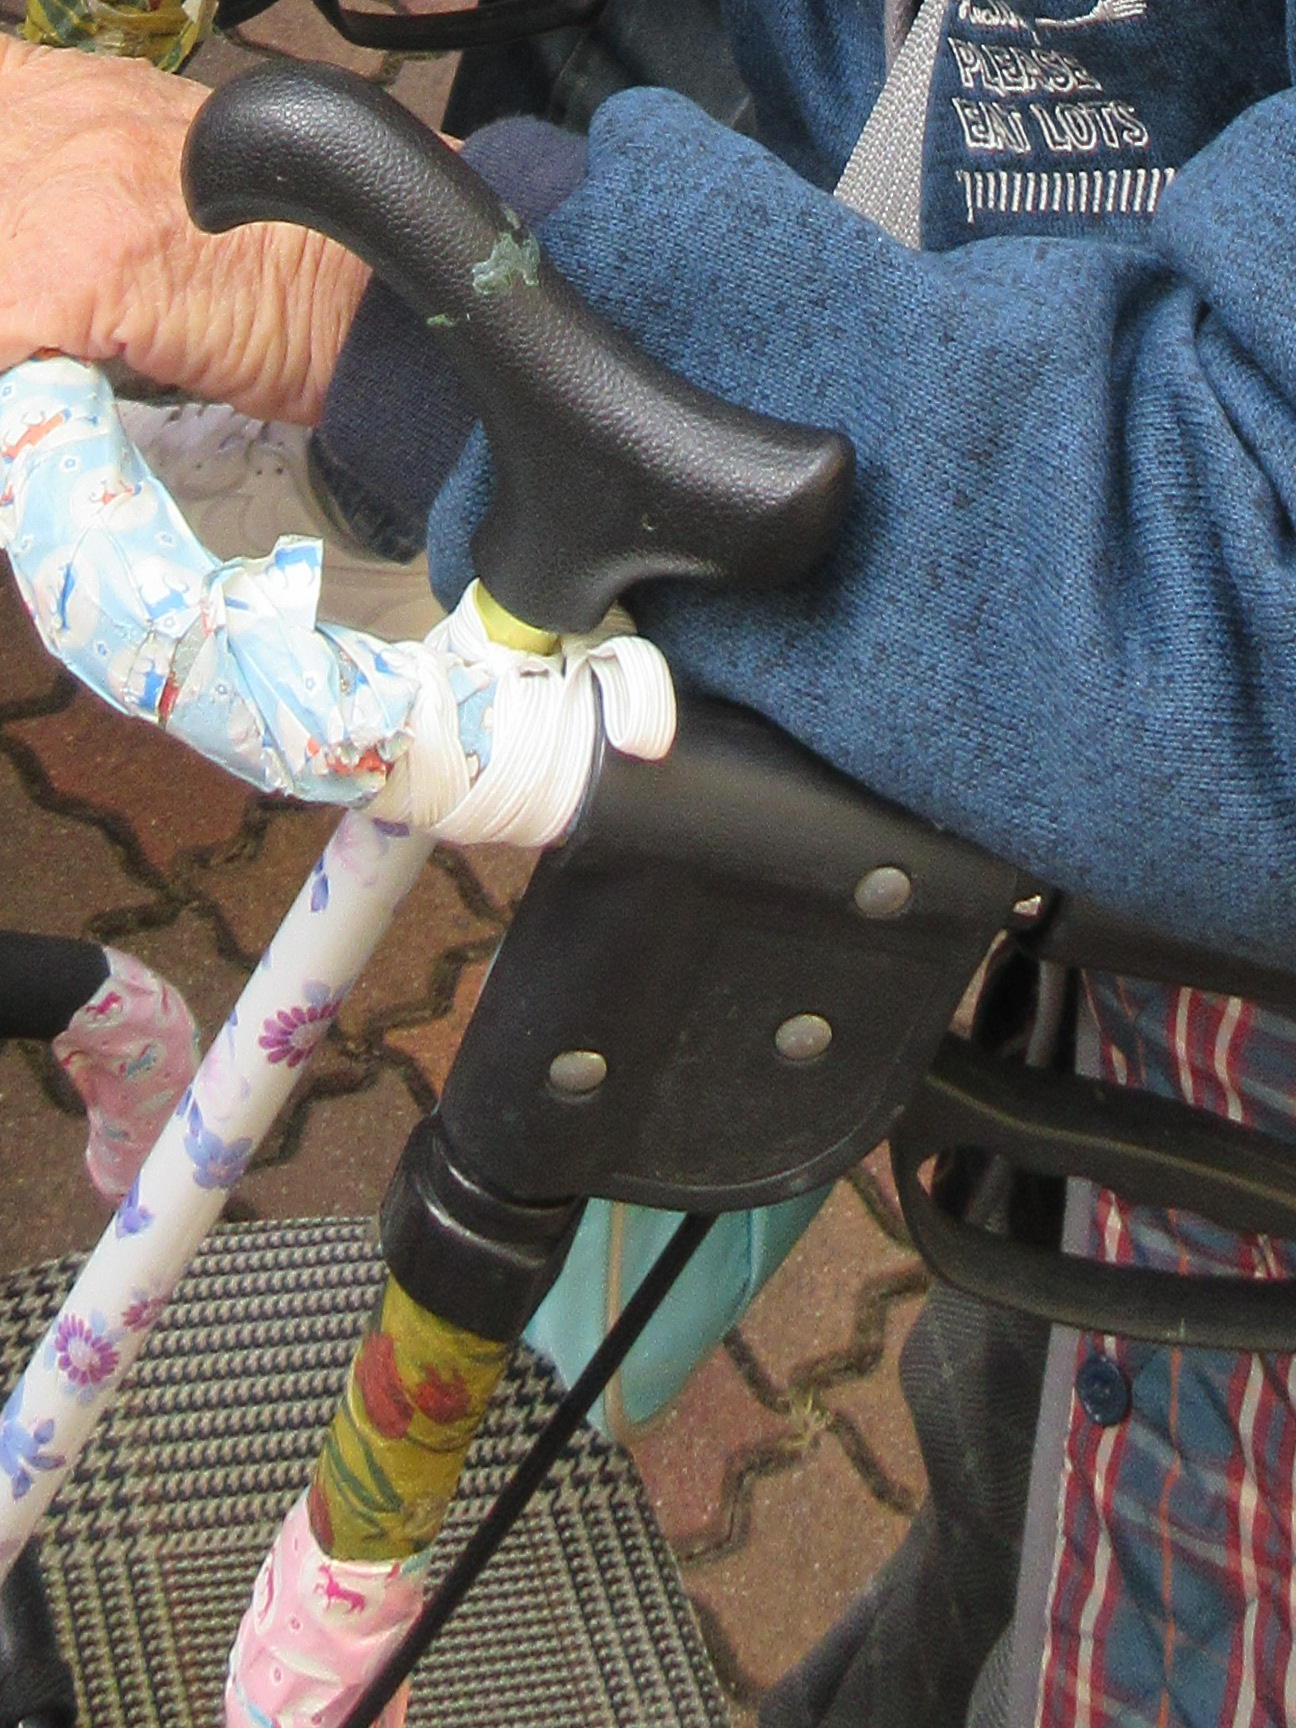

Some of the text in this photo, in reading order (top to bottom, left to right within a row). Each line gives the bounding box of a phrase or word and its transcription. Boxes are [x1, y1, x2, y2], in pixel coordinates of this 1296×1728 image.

[946, 36, 1104, 97] PLEASE
[951, 96, 1150, 155] EAT LOTS
